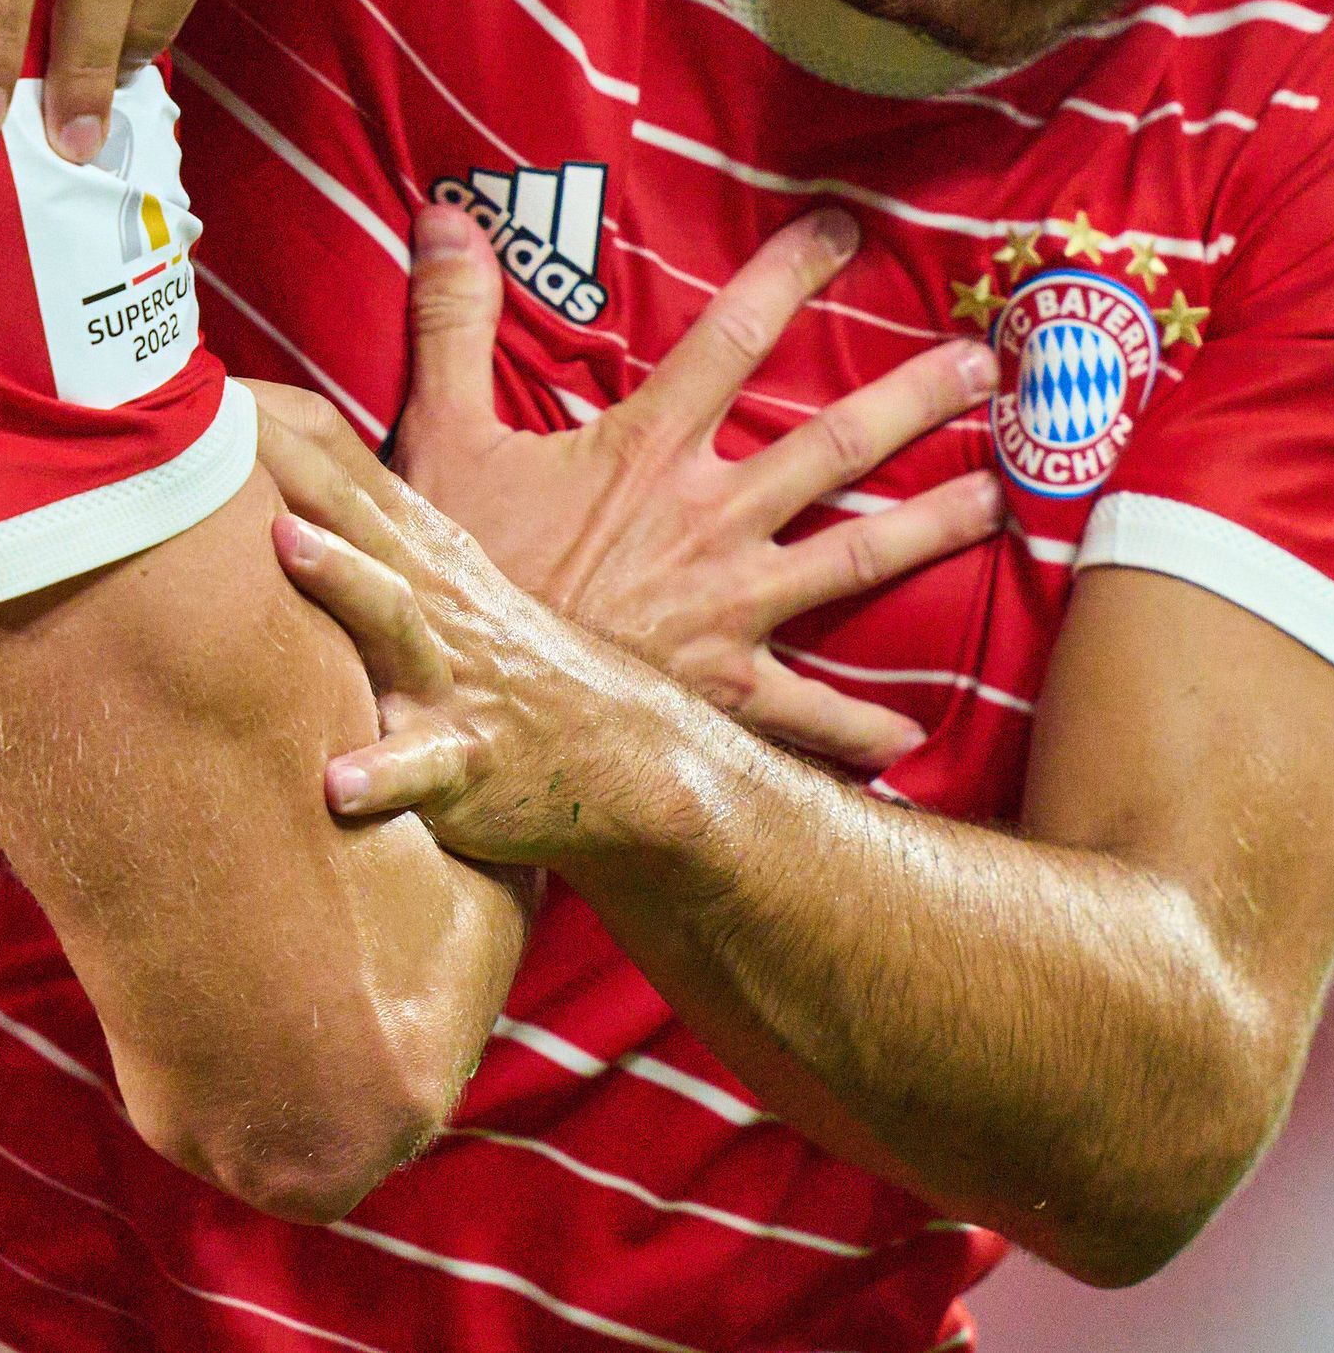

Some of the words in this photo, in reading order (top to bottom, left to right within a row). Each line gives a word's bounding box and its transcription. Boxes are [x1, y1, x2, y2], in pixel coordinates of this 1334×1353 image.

[88, 269, 190, 345] SUPERCU
[133, 314, 180, 362] 2022
[1035, 286, 1148, 378] BAYERN
